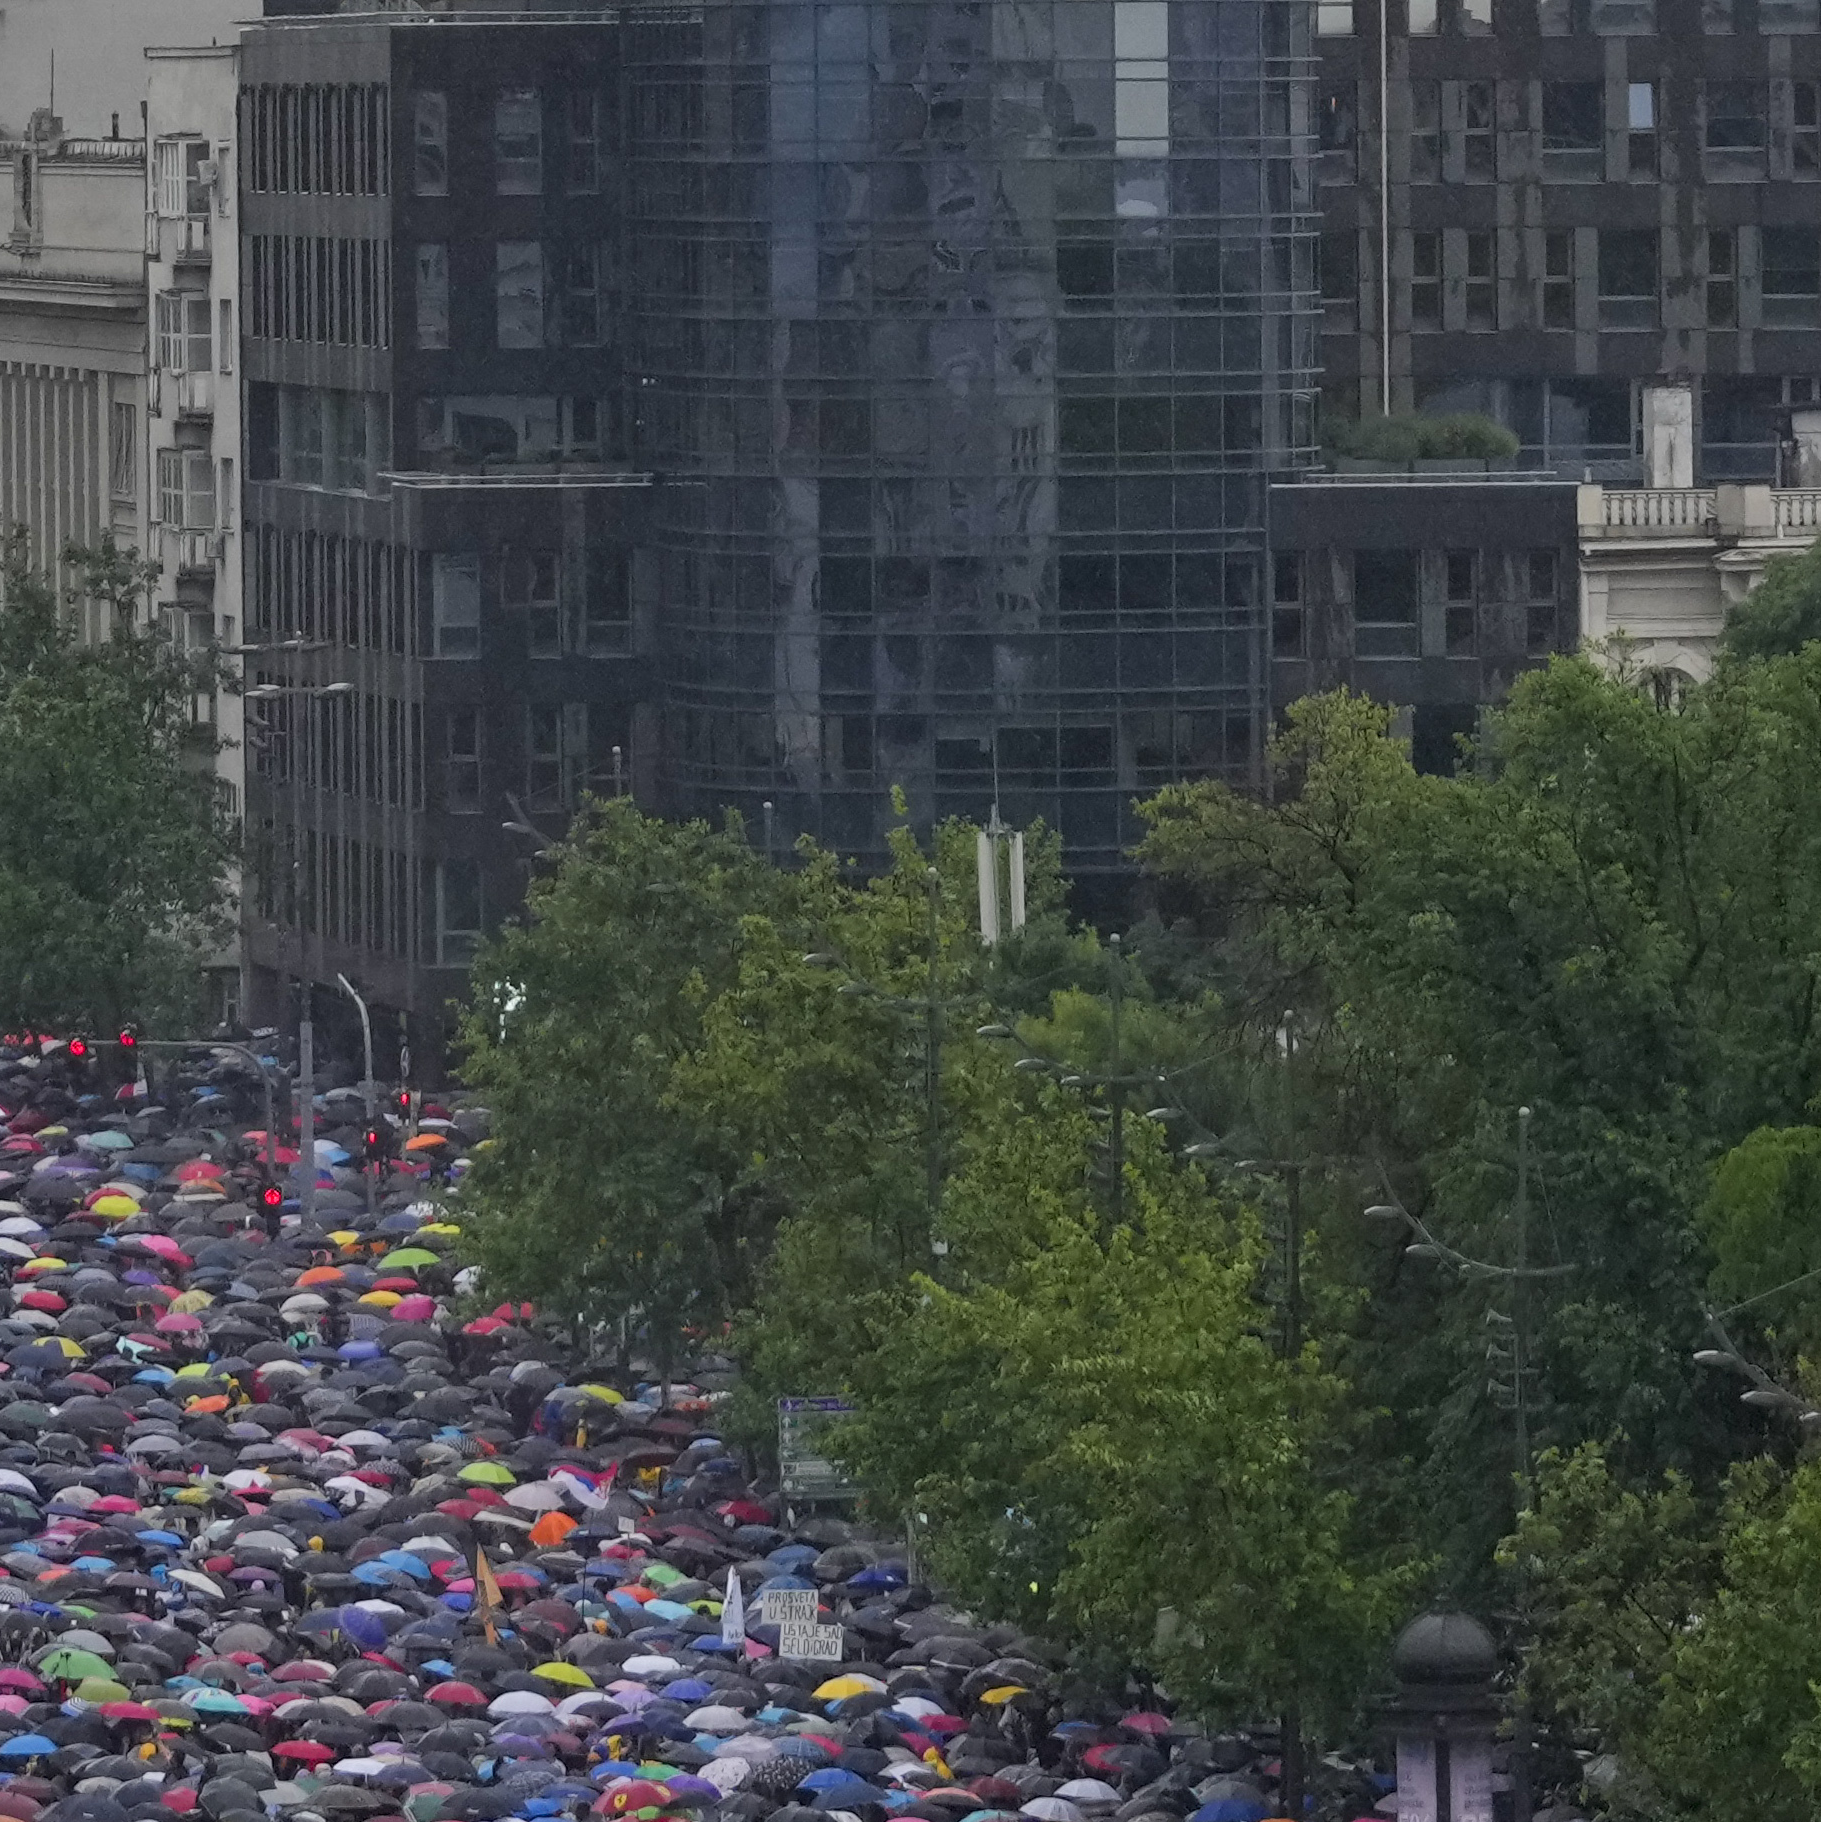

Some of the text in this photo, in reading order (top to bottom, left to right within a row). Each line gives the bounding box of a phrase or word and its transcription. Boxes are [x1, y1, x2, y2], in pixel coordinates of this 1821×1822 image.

[768, 1591, 816, 1604] PROSVETA
[769, 1605, 777, 1620] U
[783, 1624, 843, 1640] USTAJE SAD
[783, 1637, 810, 1656] SELO
